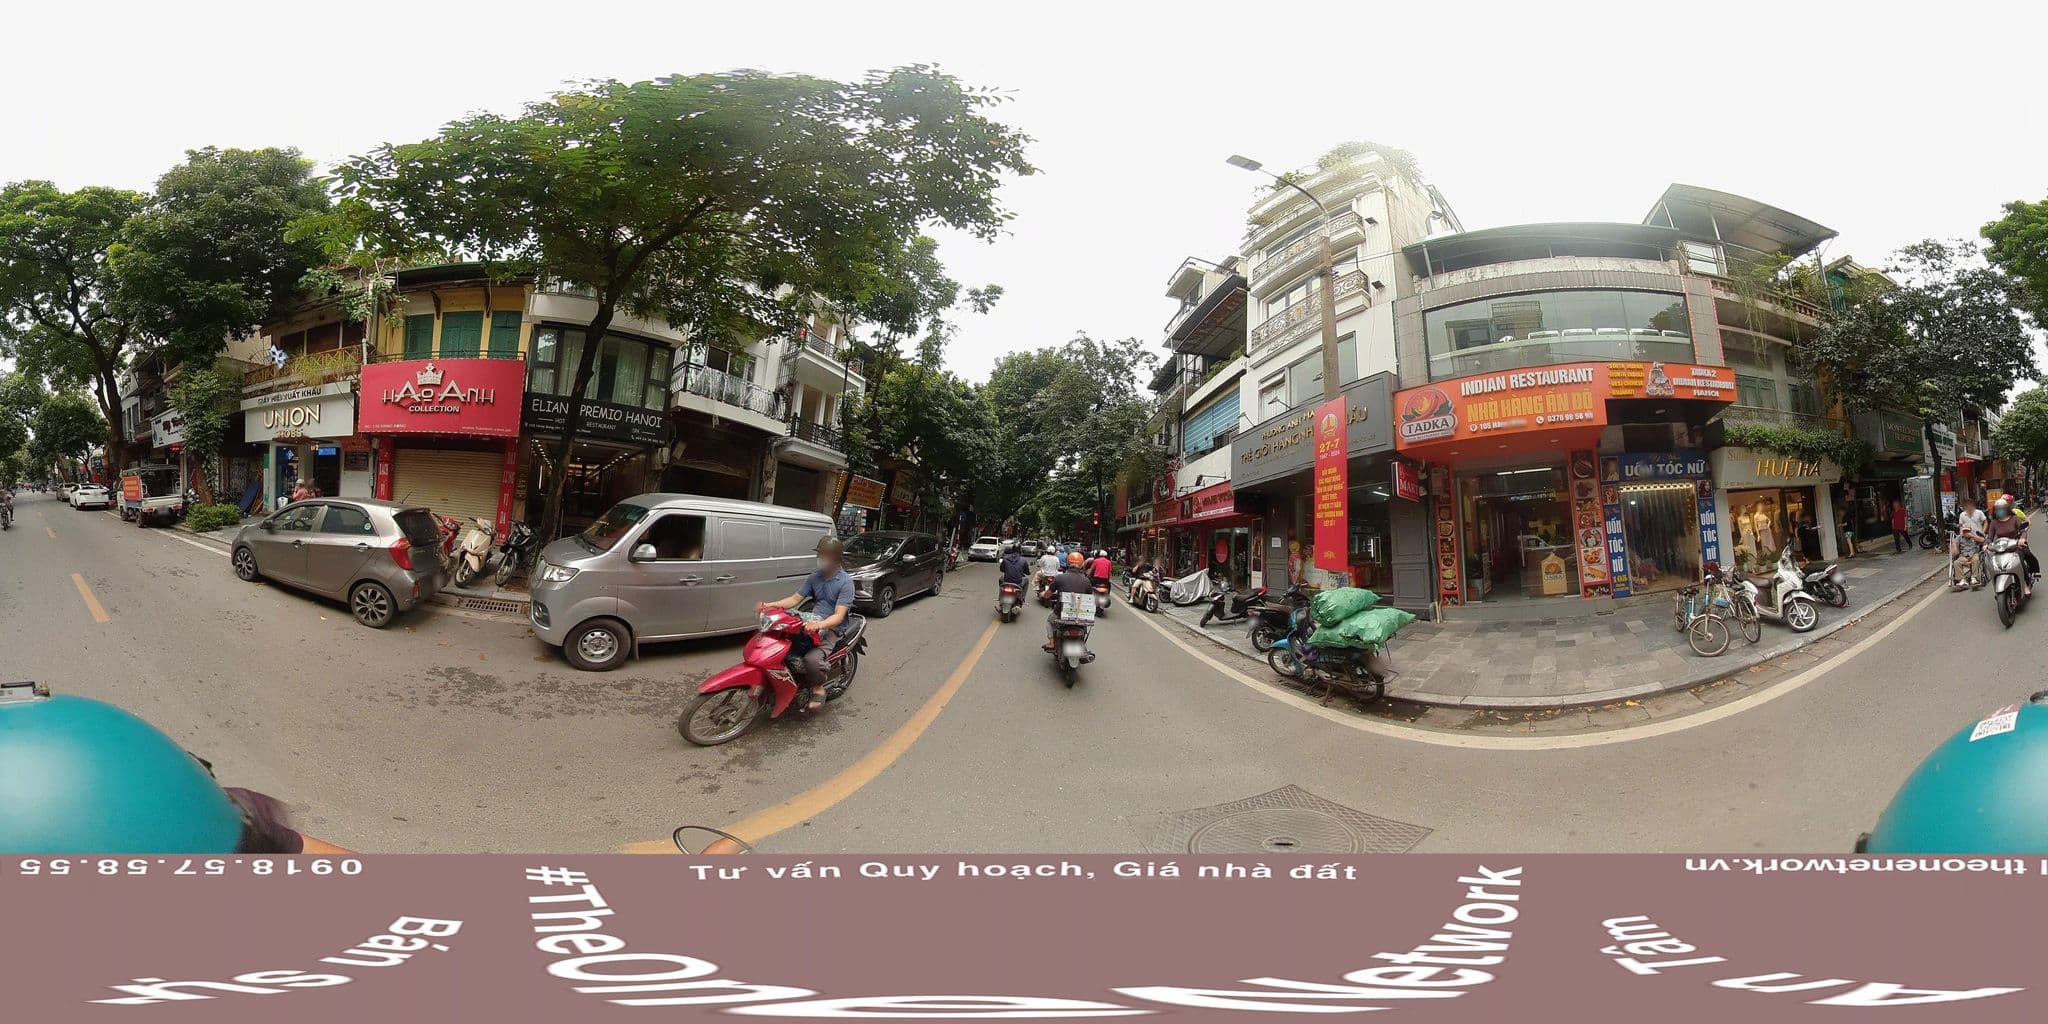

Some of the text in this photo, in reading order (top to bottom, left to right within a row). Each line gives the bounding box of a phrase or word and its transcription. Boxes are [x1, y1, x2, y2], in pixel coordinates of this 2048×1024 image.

[438, 379, 495, 404] ANH
[1460, 367, 1594, 397] INDIAN RESTAURANT
[263, 404, 321, 428] UNION
[532, 399, 662, 428] ELIAN PREMIO HANOI
[1467, 397, 1500, 423] NHÀ
[1501, 393, 1544, 418] HÀNG
[1405, 417, 1450, 433] TADKA
[1687, 459, 1706, 474] NỮ
[1608, 537, 1624, 553] TÓC
[1703, 528, 1716, 542] TÓC
